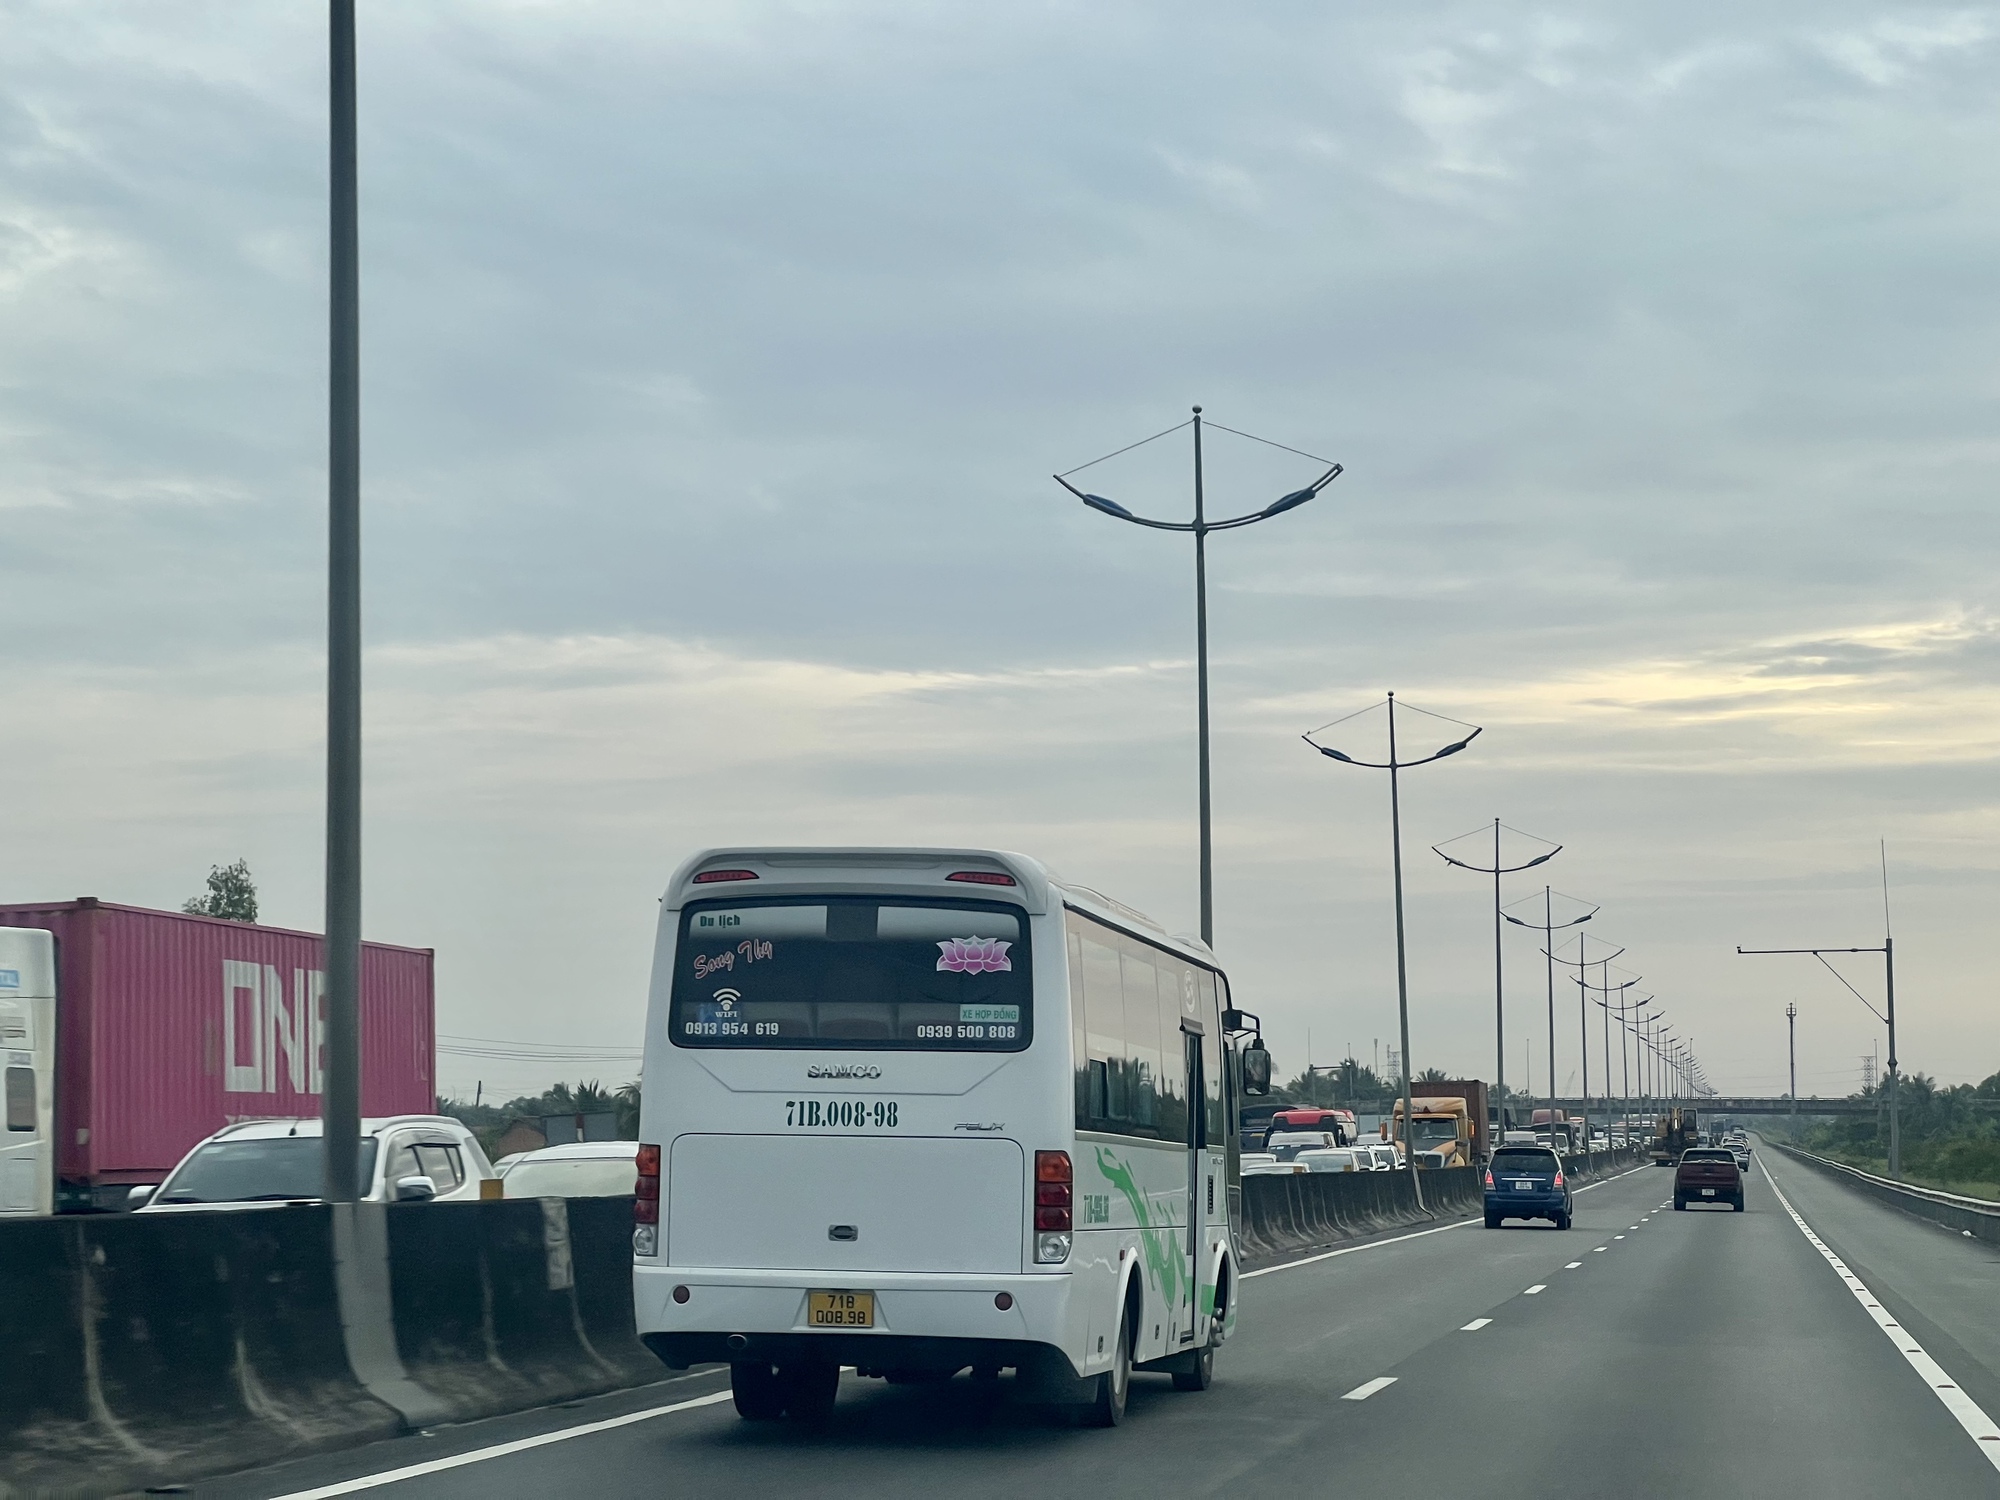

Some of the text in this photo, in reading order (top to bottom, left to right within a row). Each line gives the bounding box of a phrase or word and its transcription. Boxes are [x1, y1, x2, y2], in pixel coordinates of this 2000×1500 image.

[700, 914, 741, 928] Du lịch
[715, 1010, 738, 1018] WIFI
[962, 1009, 973, 1019] XE
[685, 1021, 779, 1036] 0913 954 619
[917, 1025, 1016, 1038] 0939 500 808
[807, 1063, 882, 1079] SAMCO
[785, 1100, 899, 1128] 71B.008-98
[827, 1294, 855, 1309] 71B
[816, 1309, 866, 1325] 008.98
